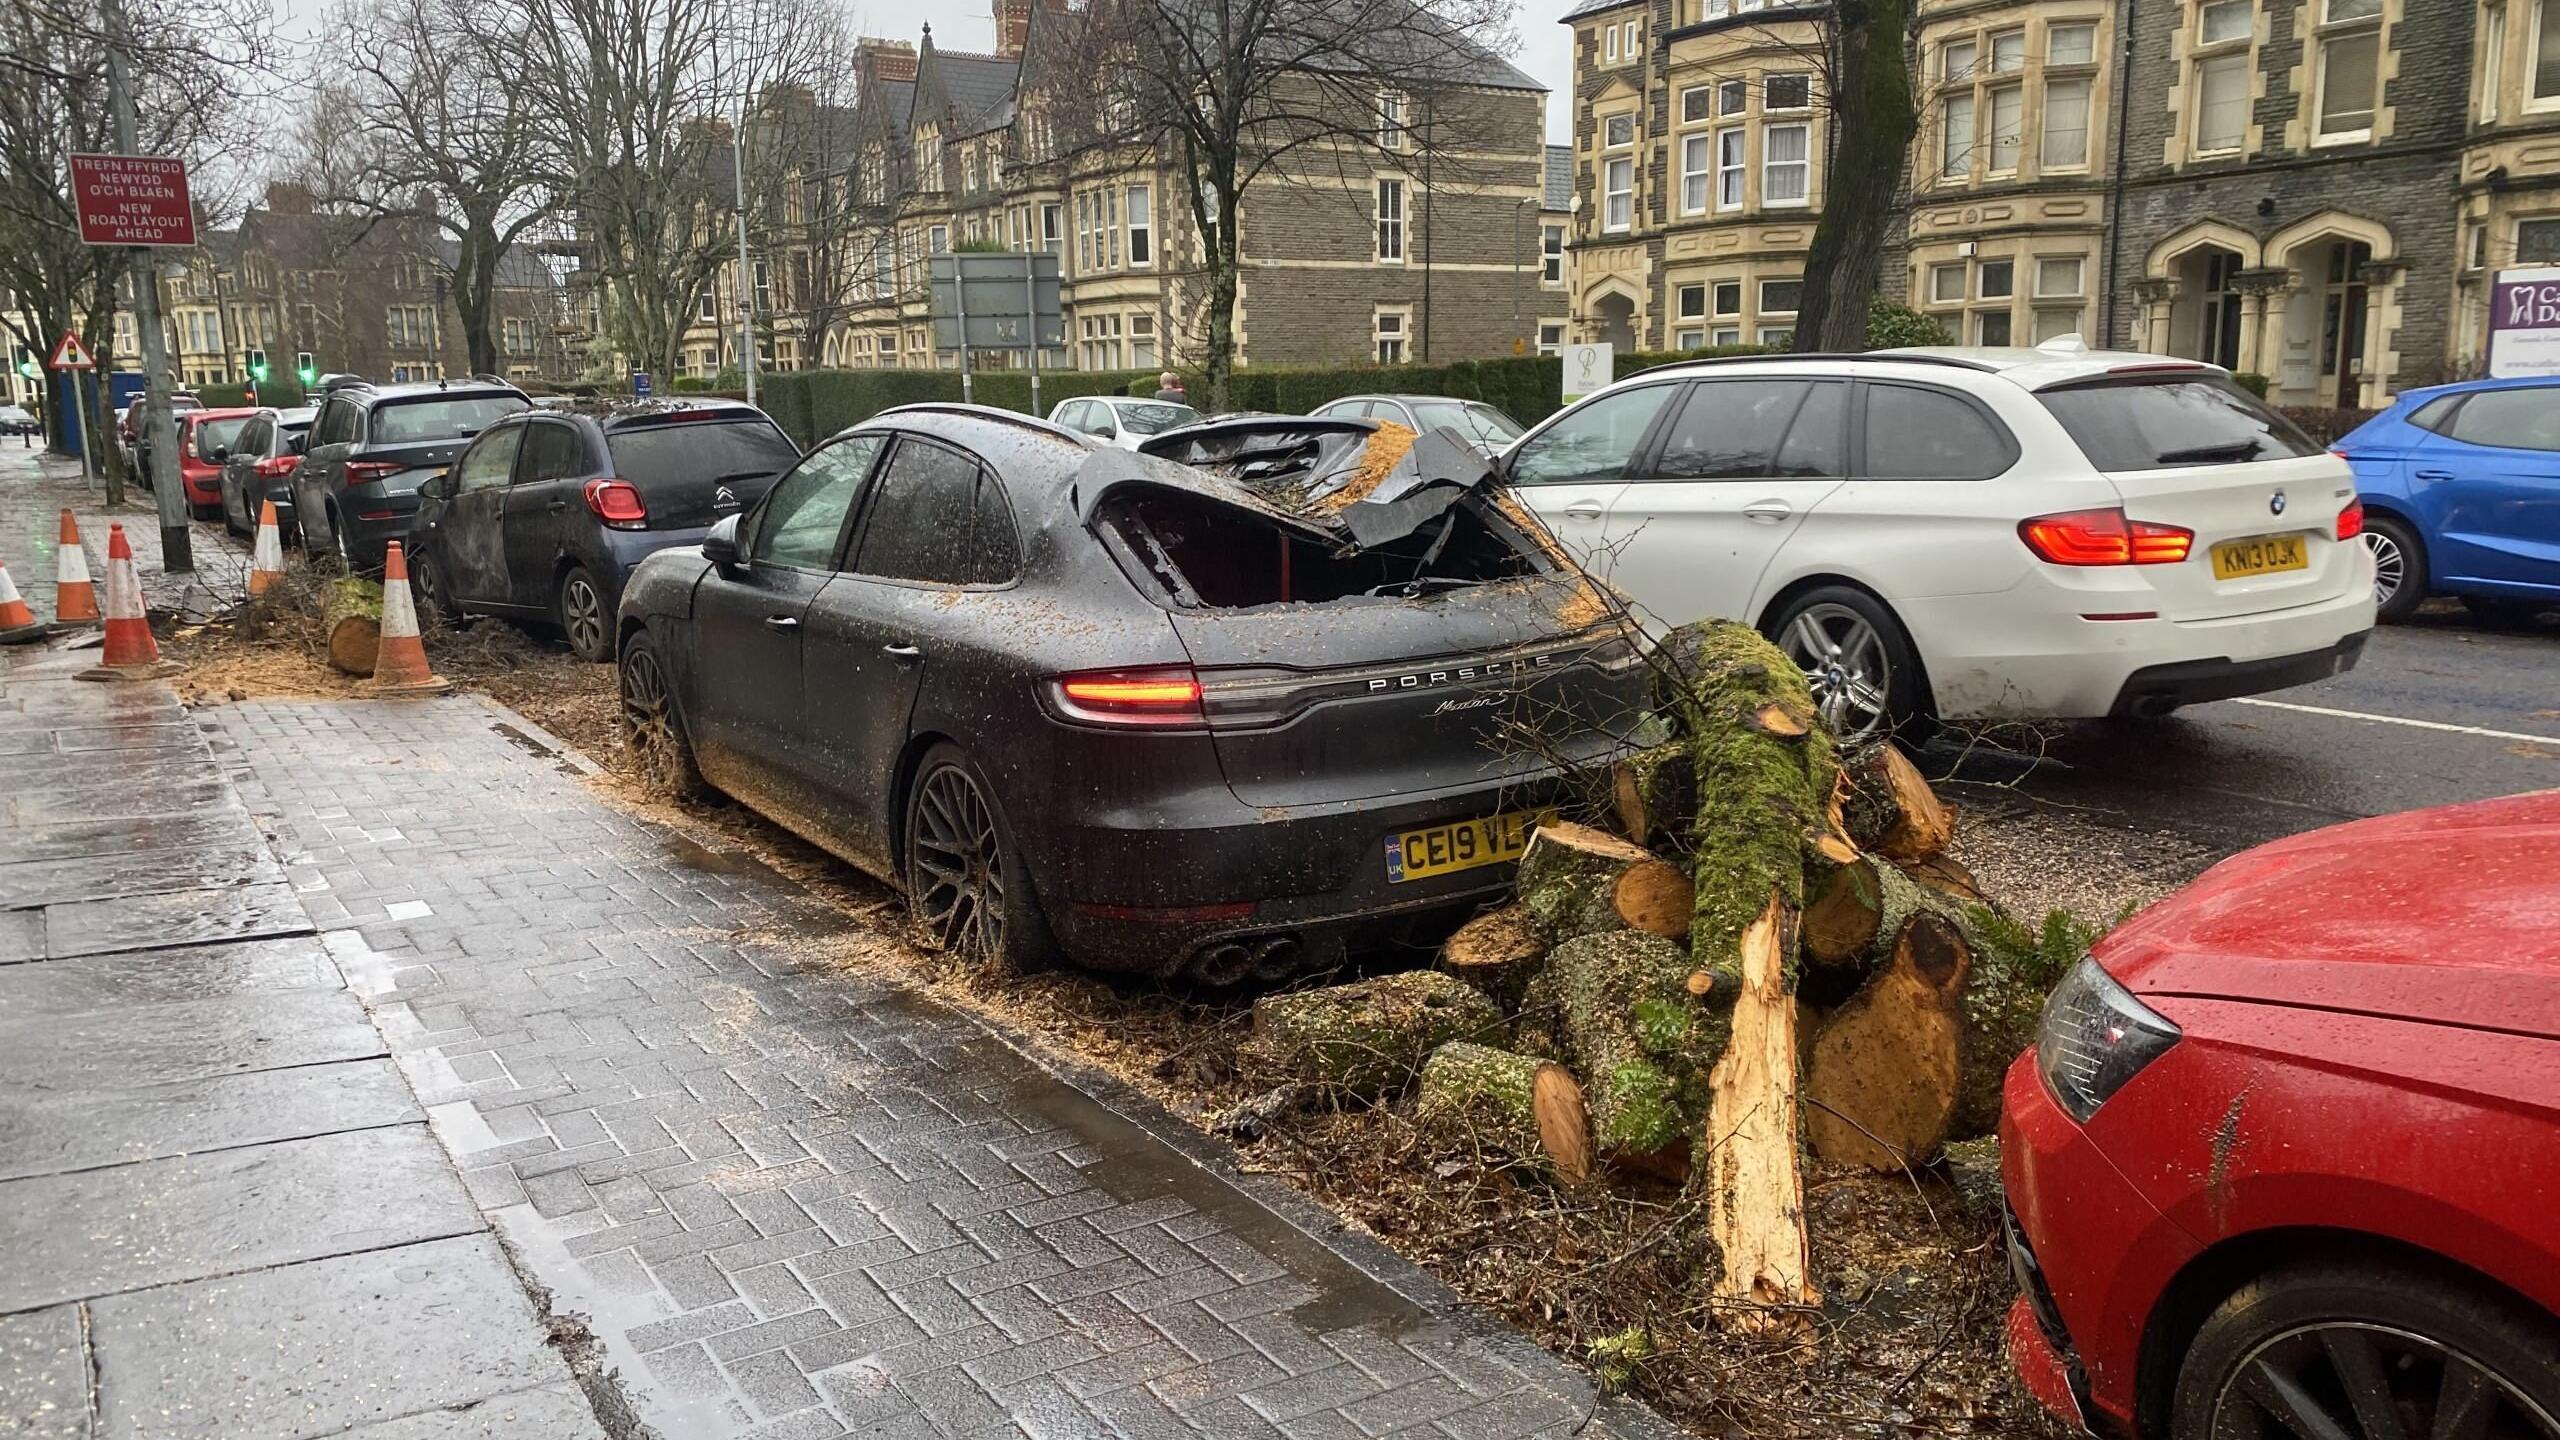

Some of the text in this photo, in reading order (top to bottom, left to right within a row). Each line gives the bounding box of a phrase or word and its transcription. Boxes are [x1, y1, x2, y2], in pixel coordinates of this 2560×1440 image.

[75, 159, 180, 173] TREFN FFYRDD
[99, 173, 161, 185] NEWYDD
[90, 184, 175, 198] O'CH BLAEN
[119, 203, 152, 214] NEW
[88, 214, 185, 227] ROAD LAYOUT
[115, 228, 163, 239] AHEAD
[2222, 544, 2263, 572] KN13
[1368, 655, 1550, 692] PORSCHE
[1422, 699, 1491, 717] Macan
[1405, 826, 1476, 870] CE19
[1388, 865, 1403, 875] UK
